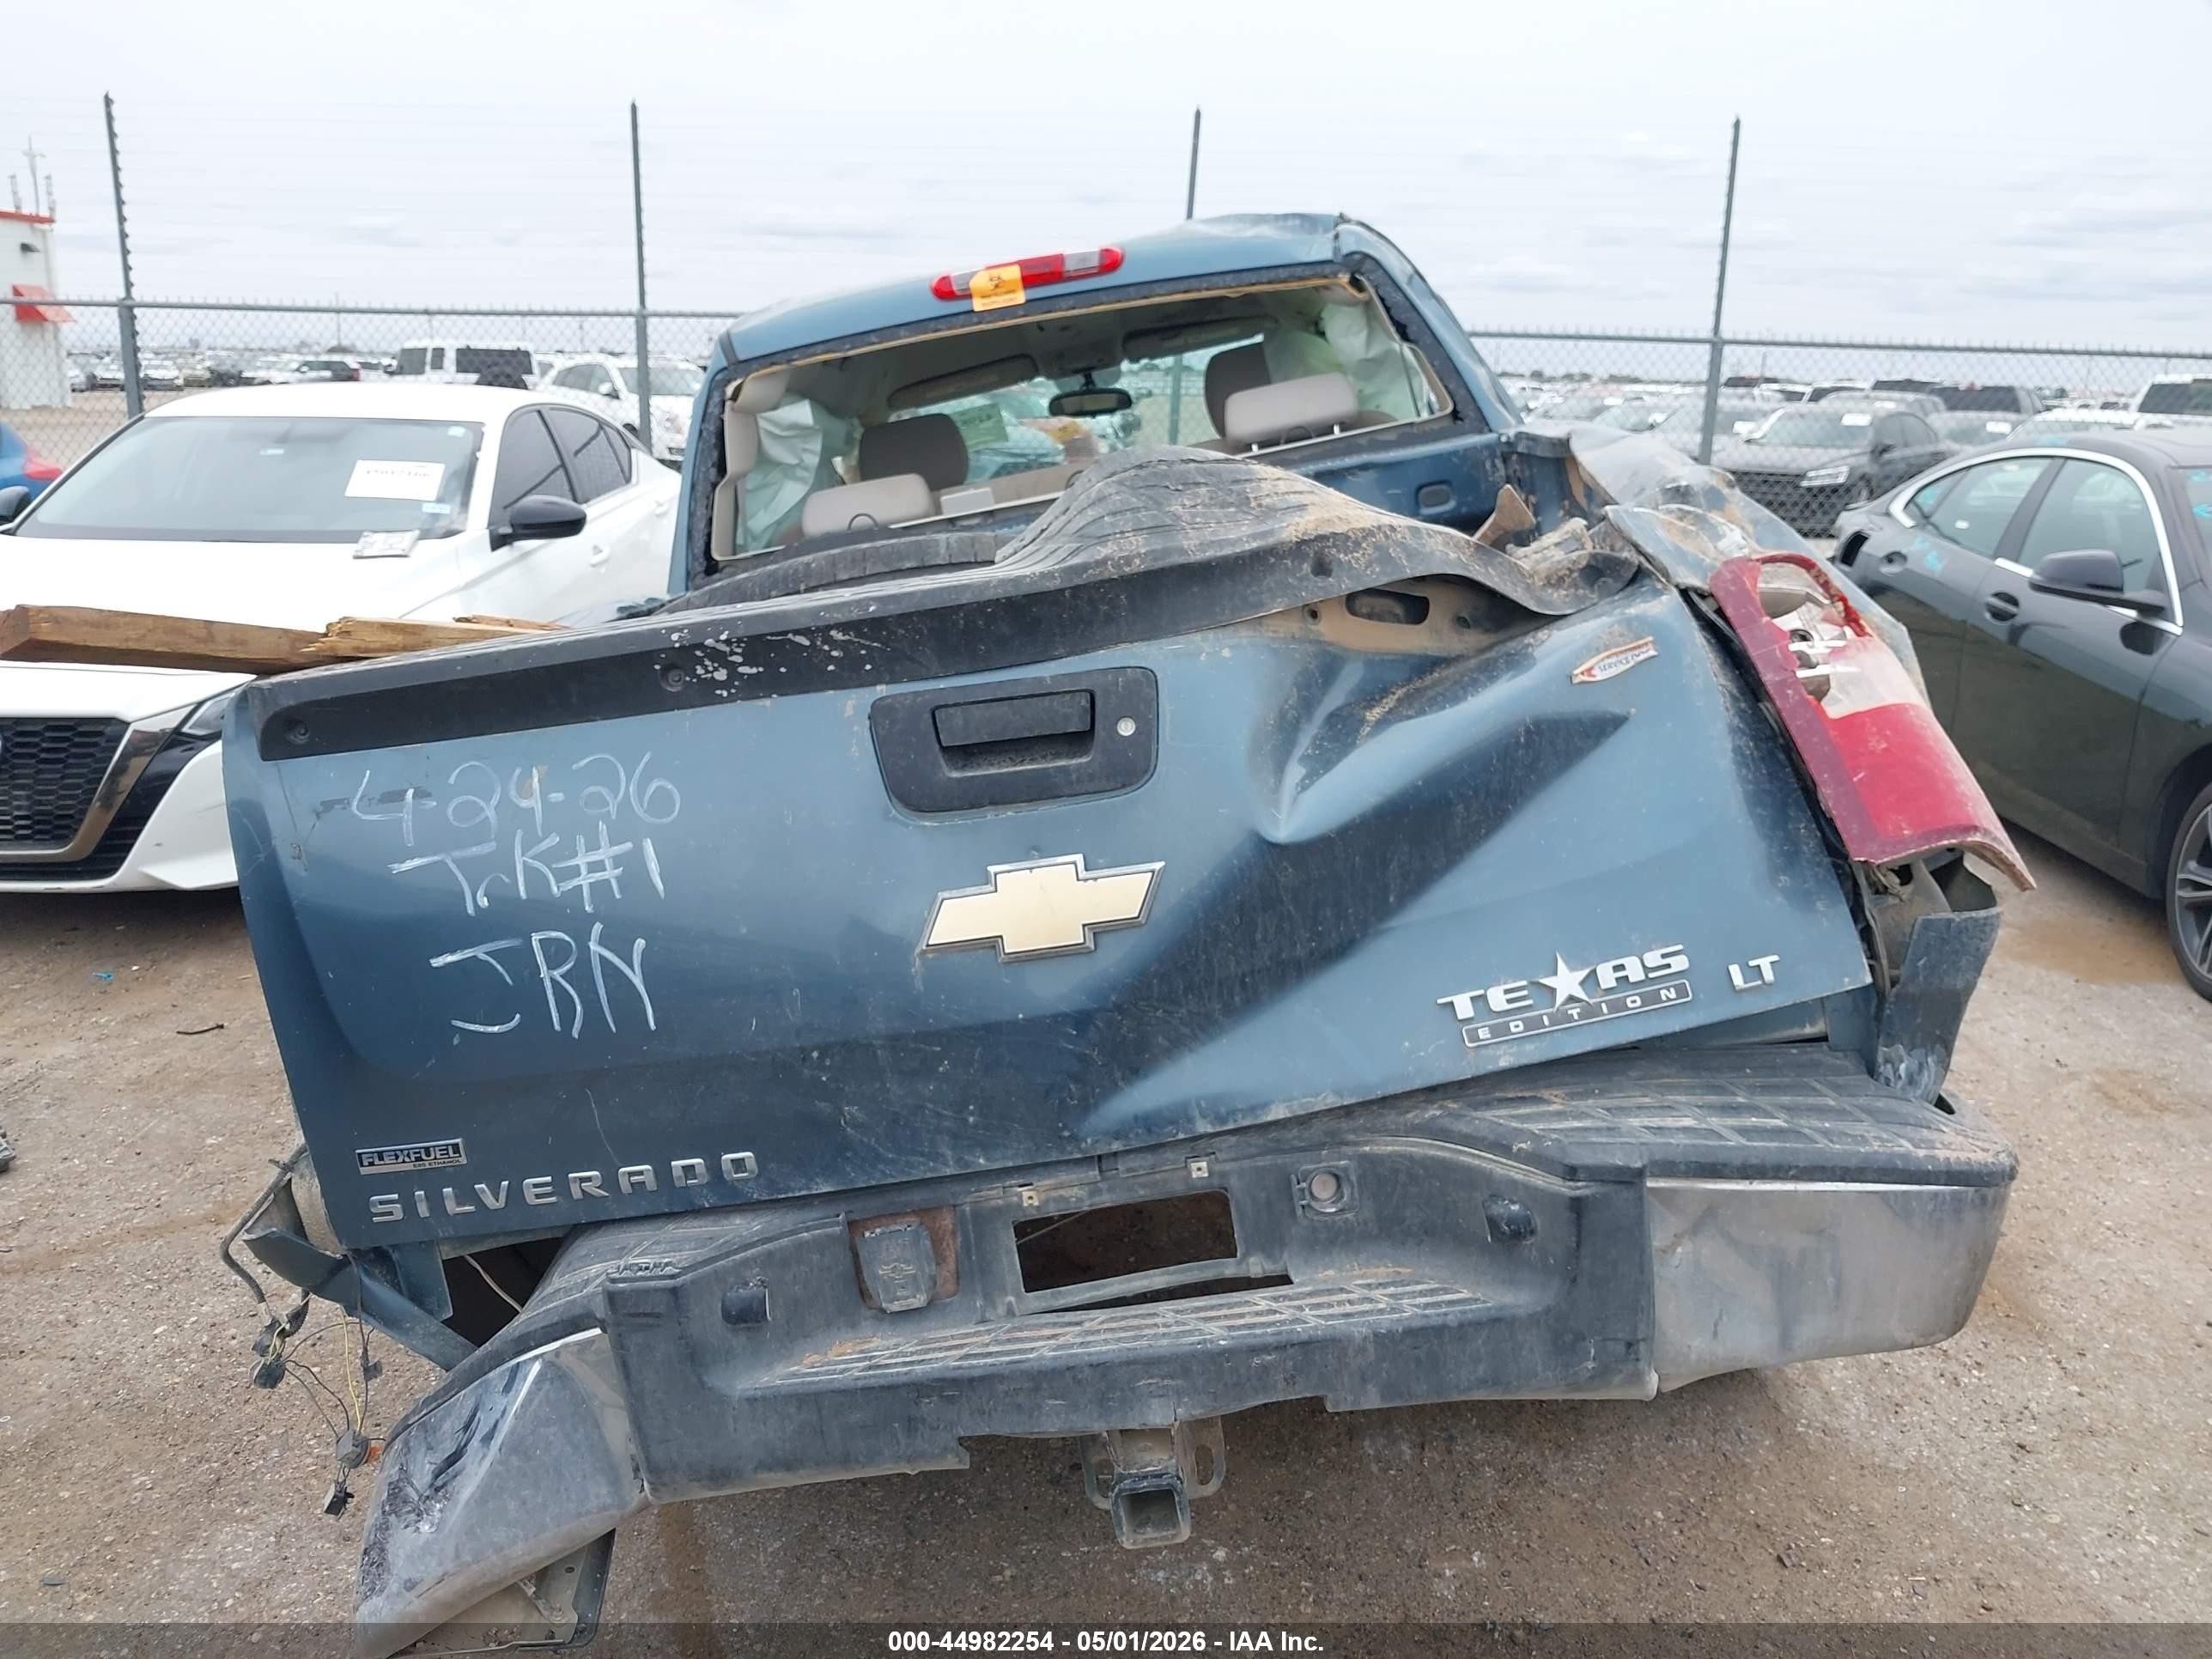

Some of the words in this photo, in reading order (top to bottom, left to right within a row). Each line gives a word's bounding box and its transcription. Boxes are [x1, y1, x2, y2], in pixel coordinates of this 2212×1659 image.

[351, 750, 681, 847] 4-24-26
[1436, 943, 1691, 1020] TEXAS
[1727, 954, 1781, 992] LT
[1476, 986, 1678, 1040] EDITION
[361, 1145, 460, 1167] FLEXFUEL
[428, 1158, 462, 1167] ETHANOL
[368, 1152, 759, 1224] SILVERADO
